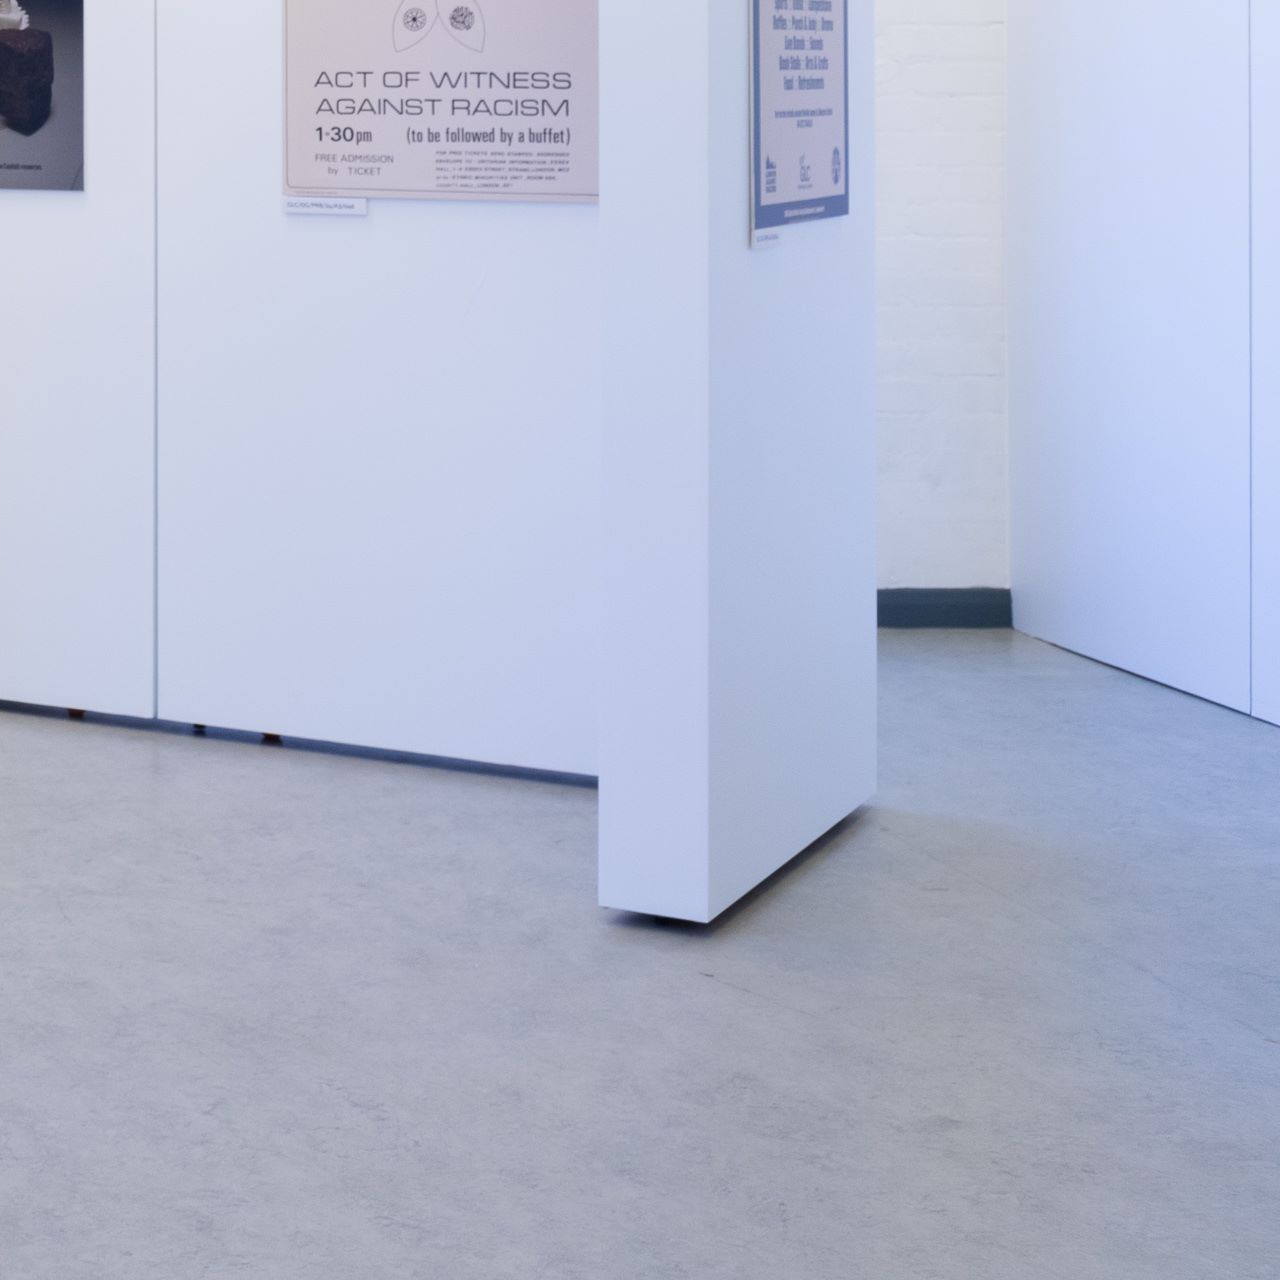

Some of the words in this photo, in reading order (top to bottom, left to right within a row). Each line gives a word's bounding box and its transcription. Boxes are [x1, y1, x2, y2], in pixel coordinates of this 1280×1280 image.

[314, 71, 373, 89] ACT
[383, 71, 421, 89] OF
[429, 71, 572, 90] WITNESS
[315, 98, 443, 116] AGAINST
[451, 99, 569, 117] RACISM
[406, 127, 423, 145] (to
[427, 127, 441, 143] be
[445, 127, 495, 144] followed
[499, 127, 513, 147] by
[518, 132, 525, 144] a
[529, 127, 571, 147] buffet)
[314, 153, 337, 164] FREE
[341, 154, 394, 165] ADMISSION
[328, 167, 338, 177] by
[348, 167, 382, 177] TICKET
